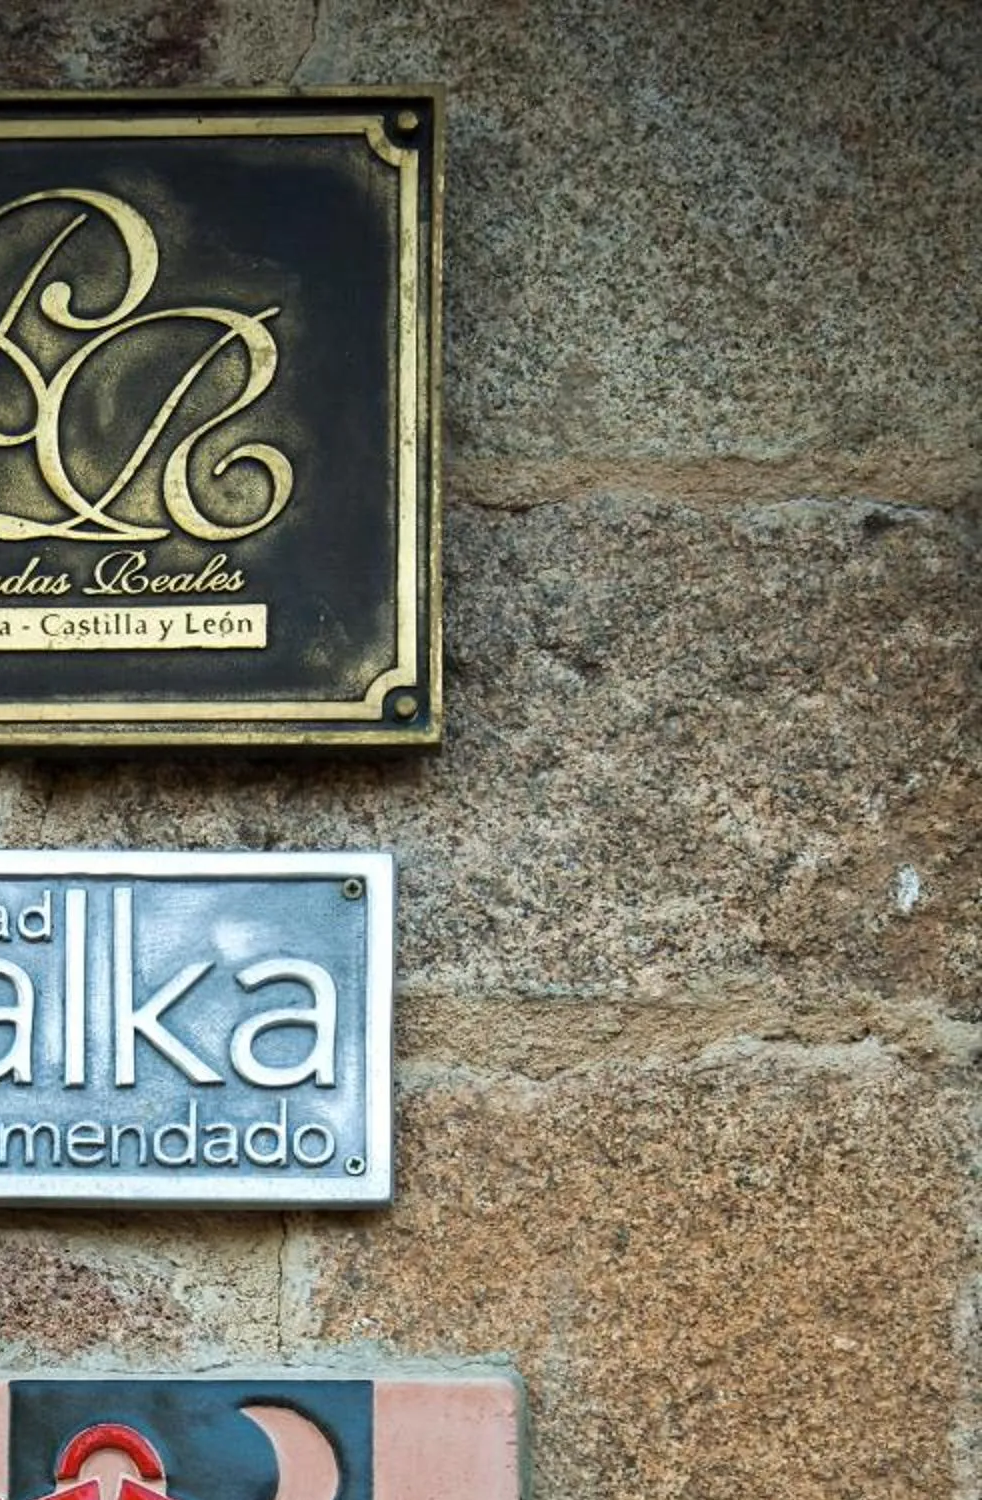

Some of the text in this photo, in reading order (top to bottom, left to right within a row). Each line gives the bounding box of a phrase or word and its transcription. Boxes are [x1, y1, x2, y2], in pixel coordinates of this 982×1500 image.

[84, 550, 245, 596] Reales
[40, 612, 149, 637] Castilla
[159, 619, 175, 640] y
[185, 610, 254, 635] León
